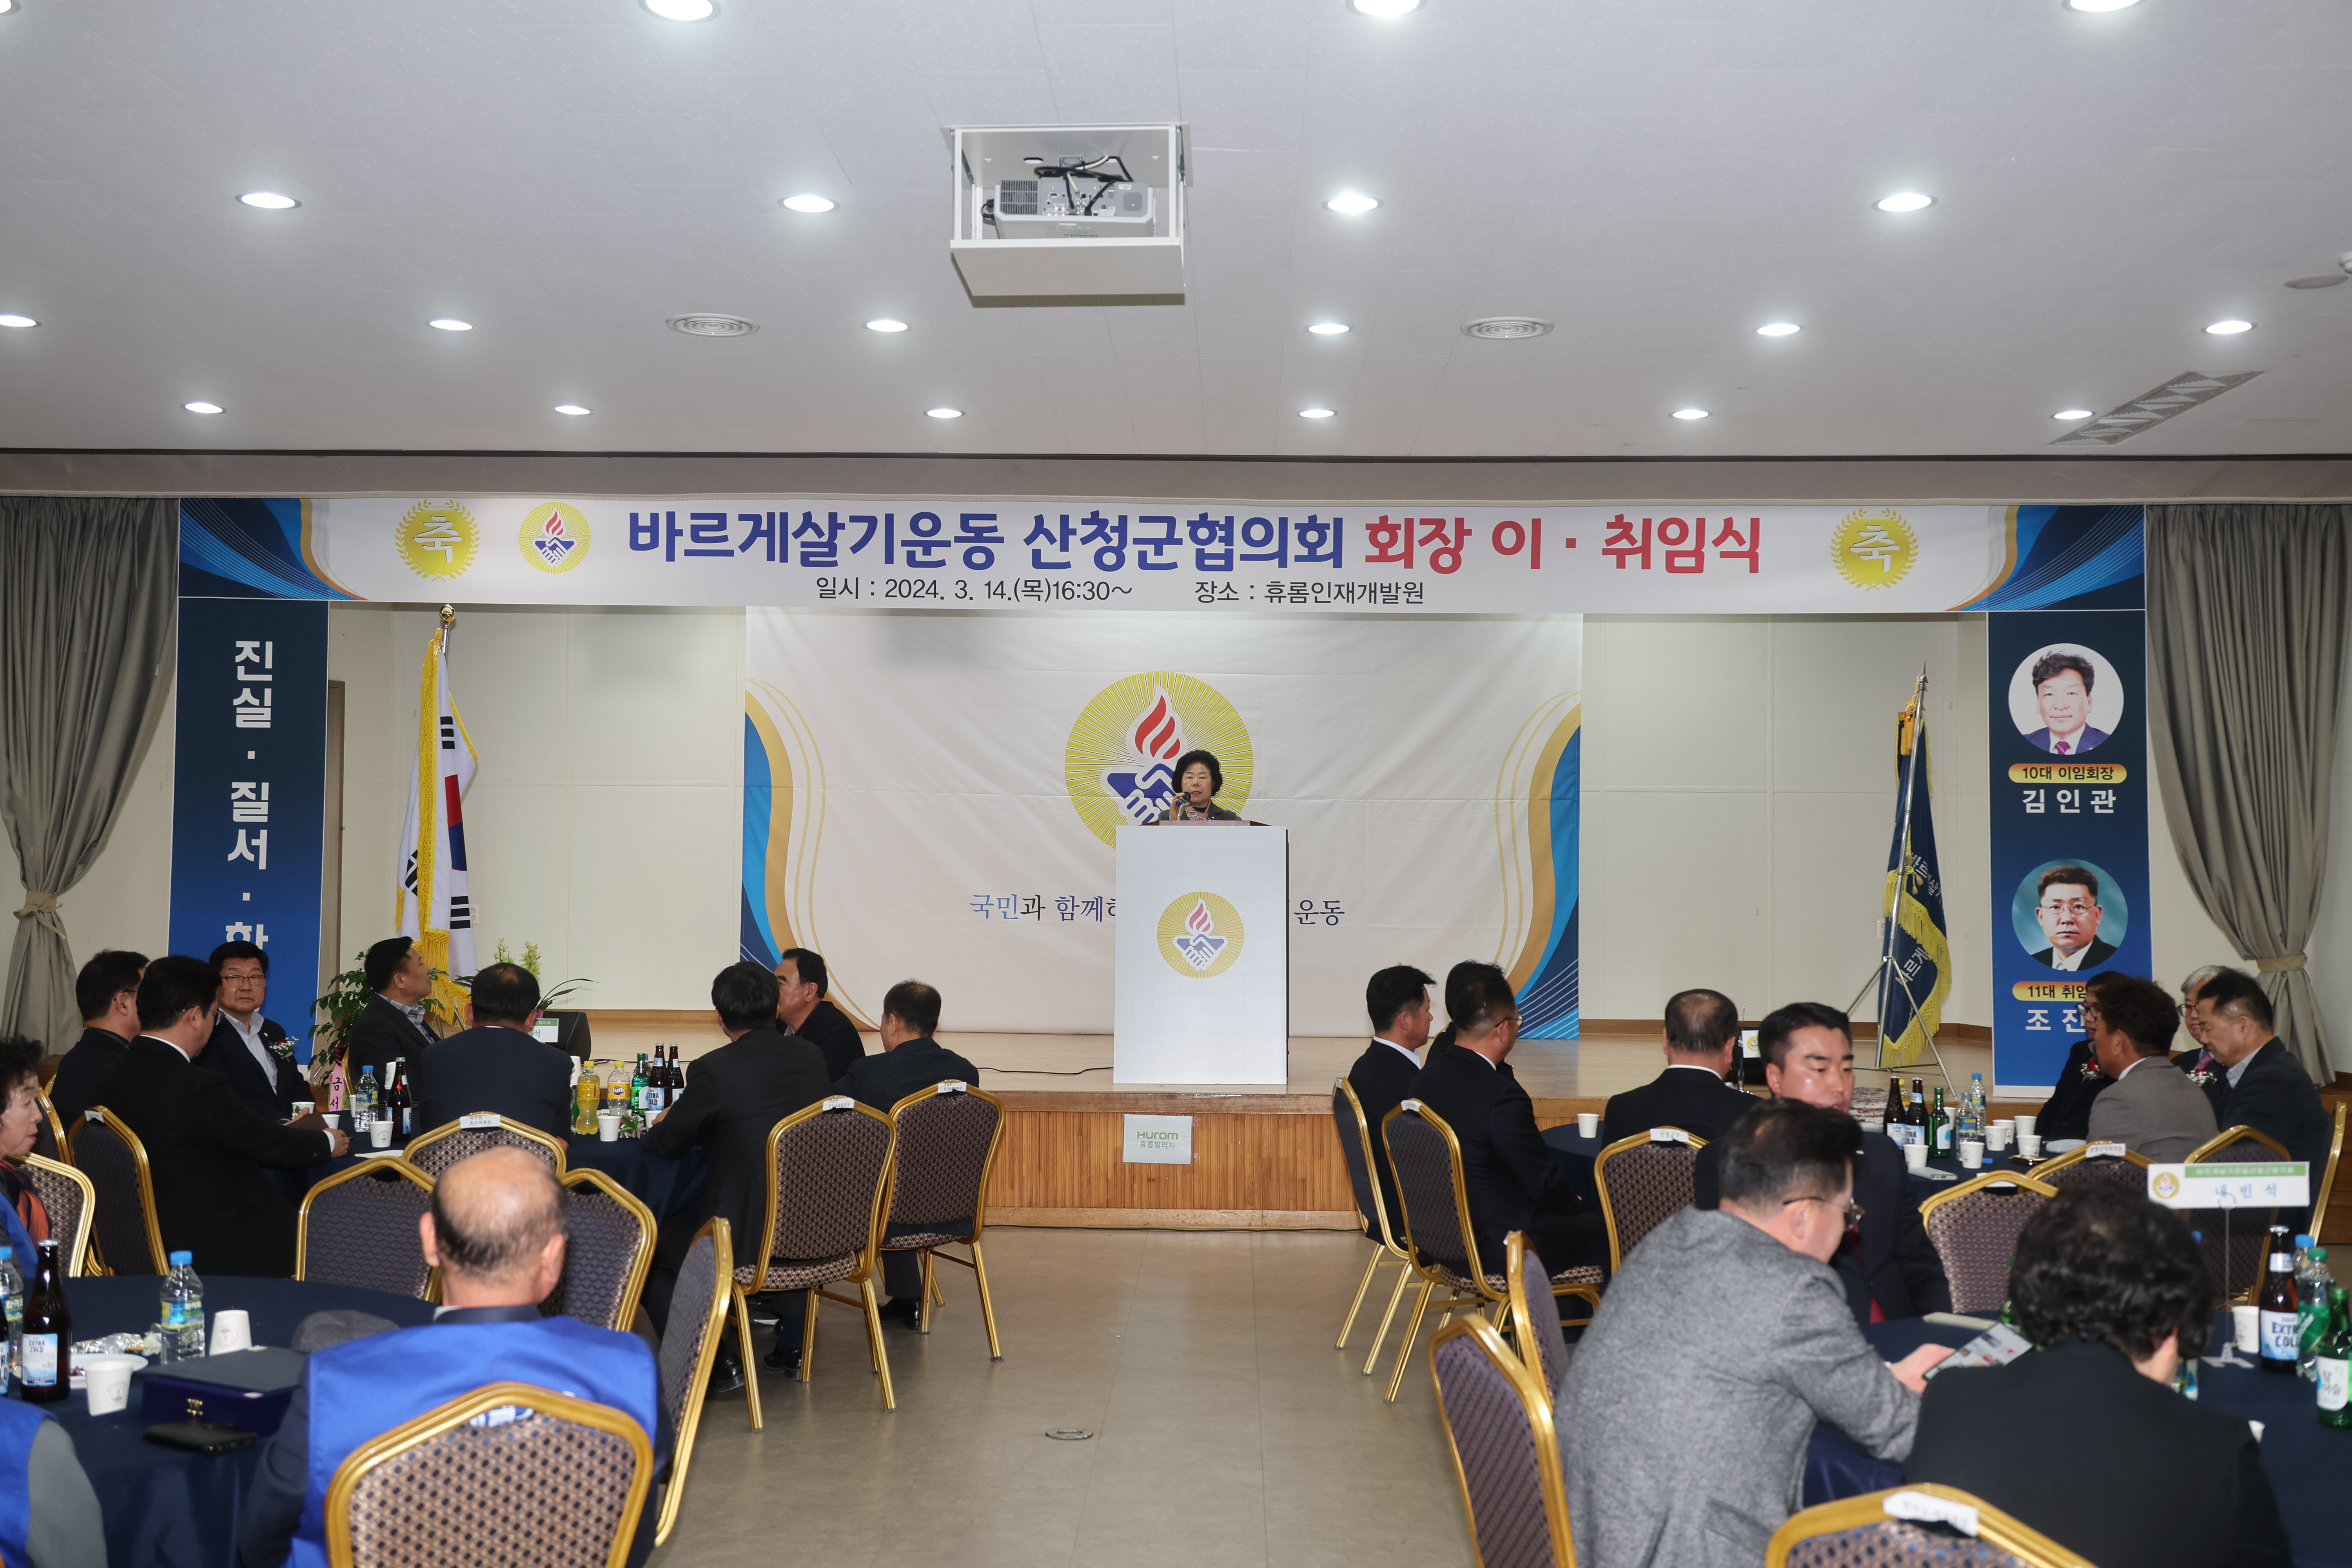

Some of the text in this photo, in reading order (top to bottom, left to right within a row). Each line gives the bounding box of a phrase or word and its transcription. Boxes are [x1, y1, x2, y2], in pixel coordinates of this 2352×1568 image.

[413, 515, 463, 563] 축
[629, 511, 1004, 570] 바르게살기운동
[1023, 510, 1343, 572] 산청군협의회
[1365, 514, 1472, 574] 회장
[1492, 518, 1541, 570] 이
[1602, 514, 1760, 573] 취임식
[1849, 524, 1900, 573] 축
[816, 577, 859, 599] 일시
[885, 579, 945, 600] 2024.
[954, 580, 974, 600] 3.
[1194, 581, 1240, 603] 장소
[1264, 581, 1424, 604] 휴롬인재개발원
[232, 641, 273, 728] 진실
[2023, 766, 2114, 780] 10대 이임회장
[227, 782, 269, 870] 질서
[969, 894, 1046, 922] 국민과
[1294, 900, 1345, 926] 운동
[2028, 985, 2087, 999] 11대 취임
[1137, 1131, 1178, 1140] Hurom
[1140, 1141, 1175, 1149] 휴롬빌리지
[2272, 1321, 2299, 1334] EXTR
